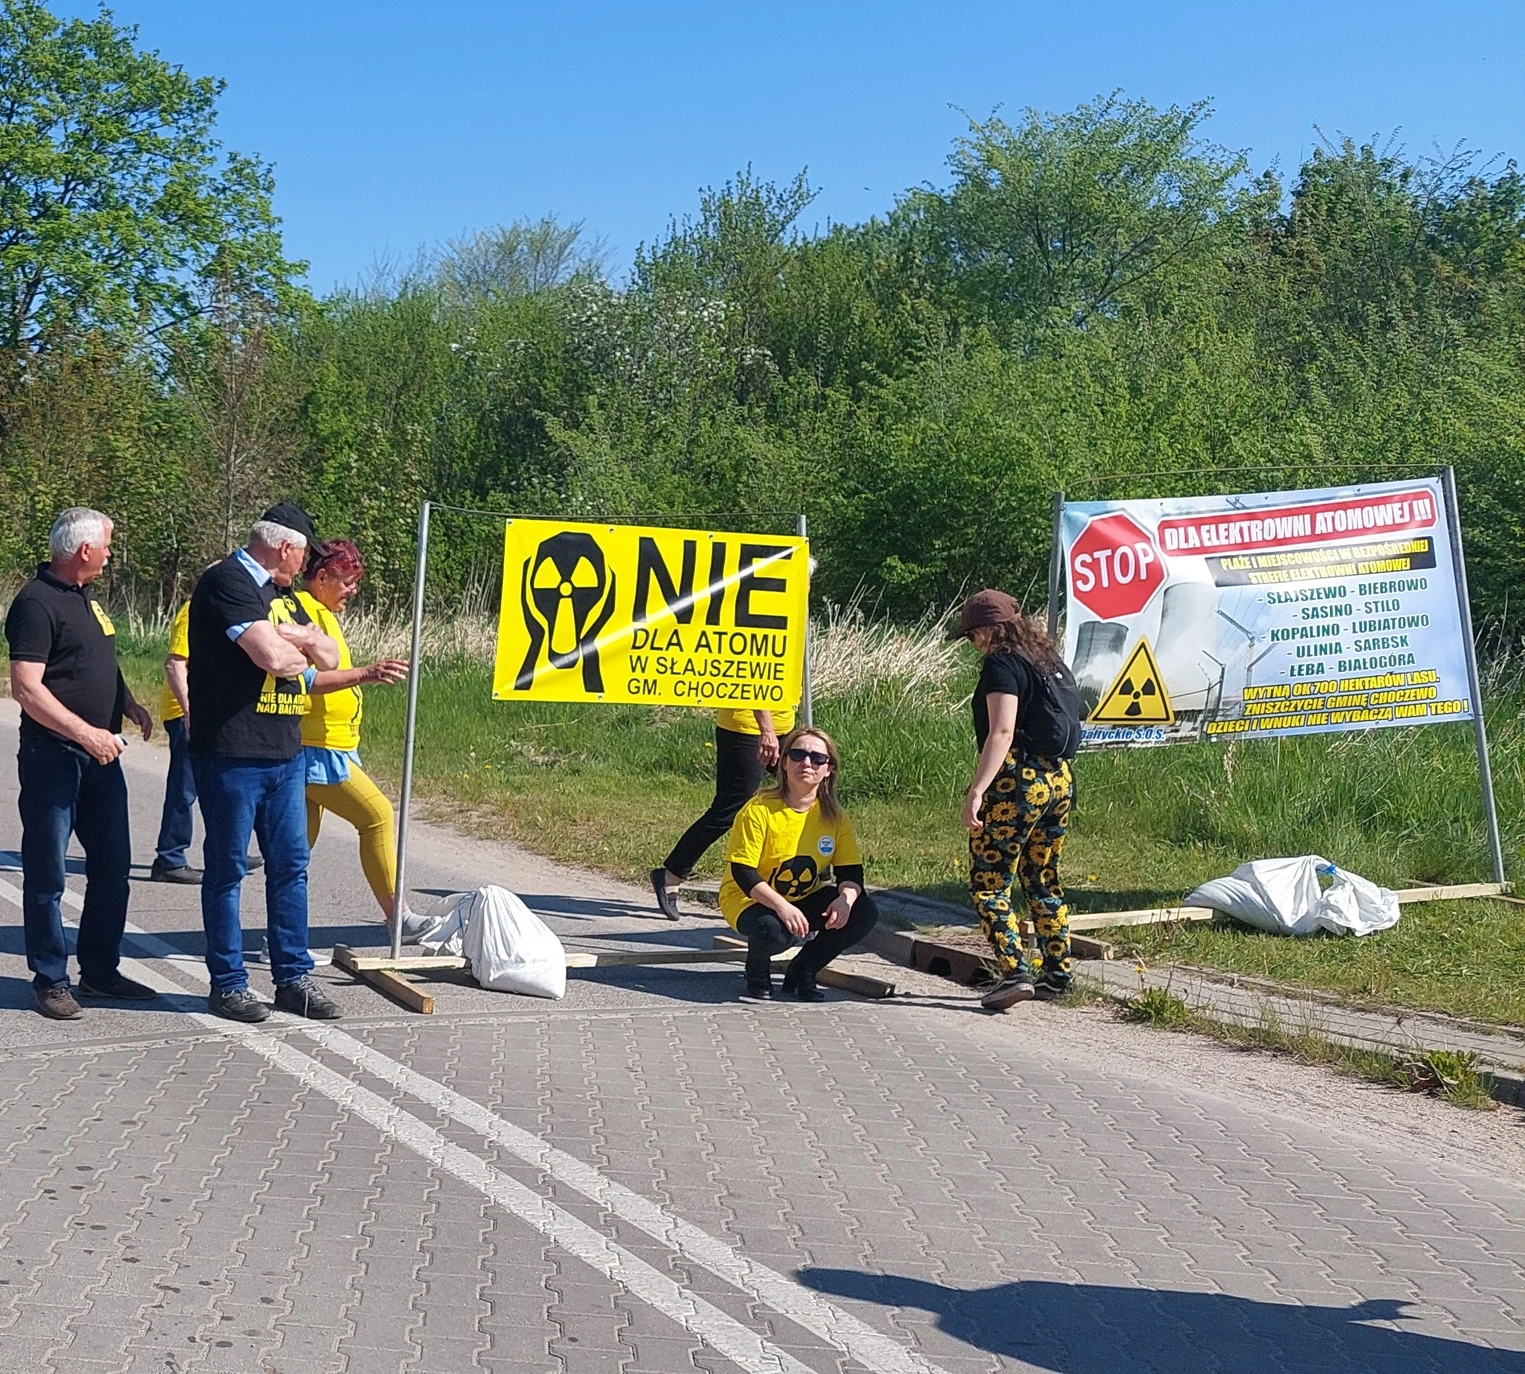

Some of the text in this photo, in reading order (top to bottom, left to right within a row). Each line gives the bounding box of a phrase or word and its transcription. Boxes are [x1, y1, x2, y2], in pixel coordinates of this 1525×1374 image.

[1164, 499, 1432, 550] DLA ELEKTROWNI ATOMOWEJ !!!
[1074, 542, 1155, 592] STOP
[1220, 556, 1252, 570] PLAŻE
[1257, 548, 1338, 567] MIEJSCOWOŚCI
[1339, 548, 1353, 560] W
[1355, 540, 1429, 559] BEZPOŚREDNIEJ
[632, 536, 794, 630] NIE
[1248, 558, 1410, 584] STREFIE ELEKTROWNI ATOMOWEJ
[1267, 585, 1346, 604] SŁAJSZEWO
[1359, 578, 1428, 596] BIEBROWO
[1301, 603, 1352, 620] SASINO
[1365, 599, 1400, 614] STILO
[1271, 624, 1340, 642] KOPALINO
[1352, 614, 1429, 634] LUBIATOWO
[631, 628, 787, 658] DLA ATOMU
[1296, 642, 1342, 658] ULINIA
[1354, 635, 1409, 652] SARBSK
[629, 655, 785, 680] W SŁAJSZEWIE
[1290, 662, 1325, 677] ŁEBA
[1338, 652, 1415, 673] BIAŁOGÓRA
[627, 678, 783, 702] GM. CHOCZEWO
[1243, 669, 1440, 700] WYTNĄ OK 700 HEKTARÓW LASU.
[256, 702, 277, 714] NAD
[260, 693, 276, 703] NIE
[278, 693, 292, 704] DLA
[1244, 686, 1437, 716] ZNISZCZYCIE GMINĘ CHOCZEWO
[1206, 719, 1249, 735] DZIECI
[1251, 719, 1257, 731] I
[1260, 714, 1305, 730] WNUKI
[1306, 712, 1328, 727] NIE
[1330, 706, 1393, 725] WYBACZĄ
[1395, 703, 1427, 718] WAM
[1430, 699, 1461, 715] TEGO
[1135, 728, 1165, 740] S.O.S.
